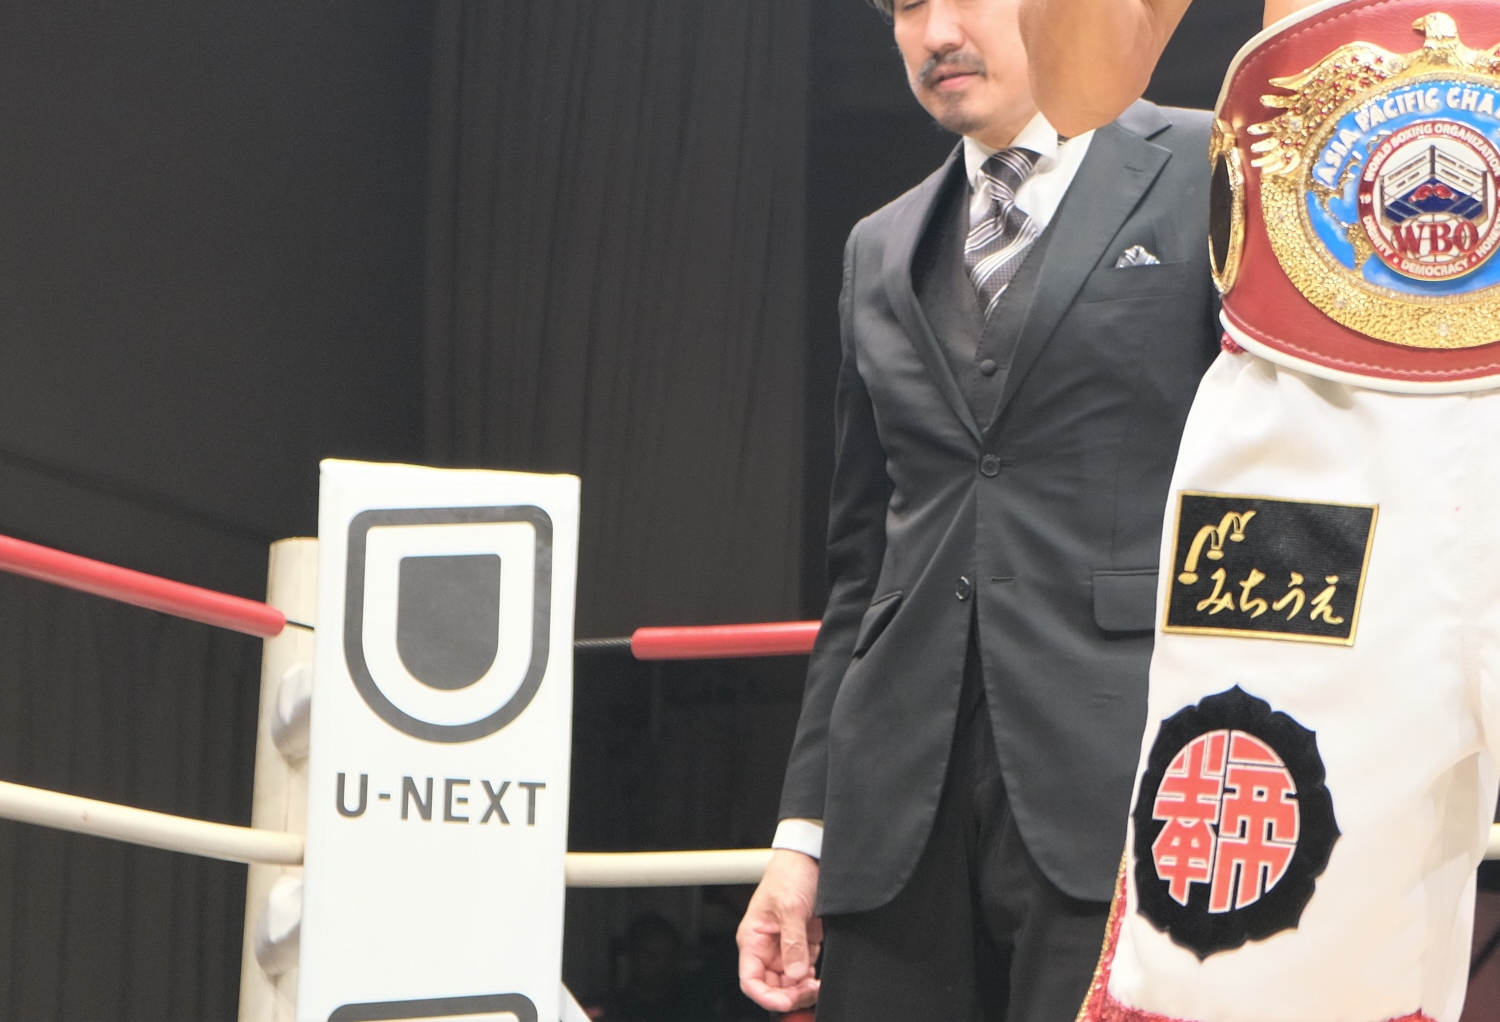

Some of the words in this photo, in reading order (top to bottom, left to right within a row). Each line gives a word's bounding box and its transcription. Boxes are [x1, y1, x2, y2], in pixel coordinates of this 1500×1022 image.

[1317, 129, 1360, 185] ASIA
[1354, 87, 1440, 132] PACIFIC
[1363, 142, 1393, 181] WORLD
[1390, 123, 1433, 148] BOXING
[1362, 214, 1394, 257] DIGNITY
[1400, 257, 1469, 277] DEMOCRACY
[1391, 220, 1479, 255] WBO
[1196, 567, 1345, 625] みちうえ
[335, 771, 547, 827] U-NEXT
